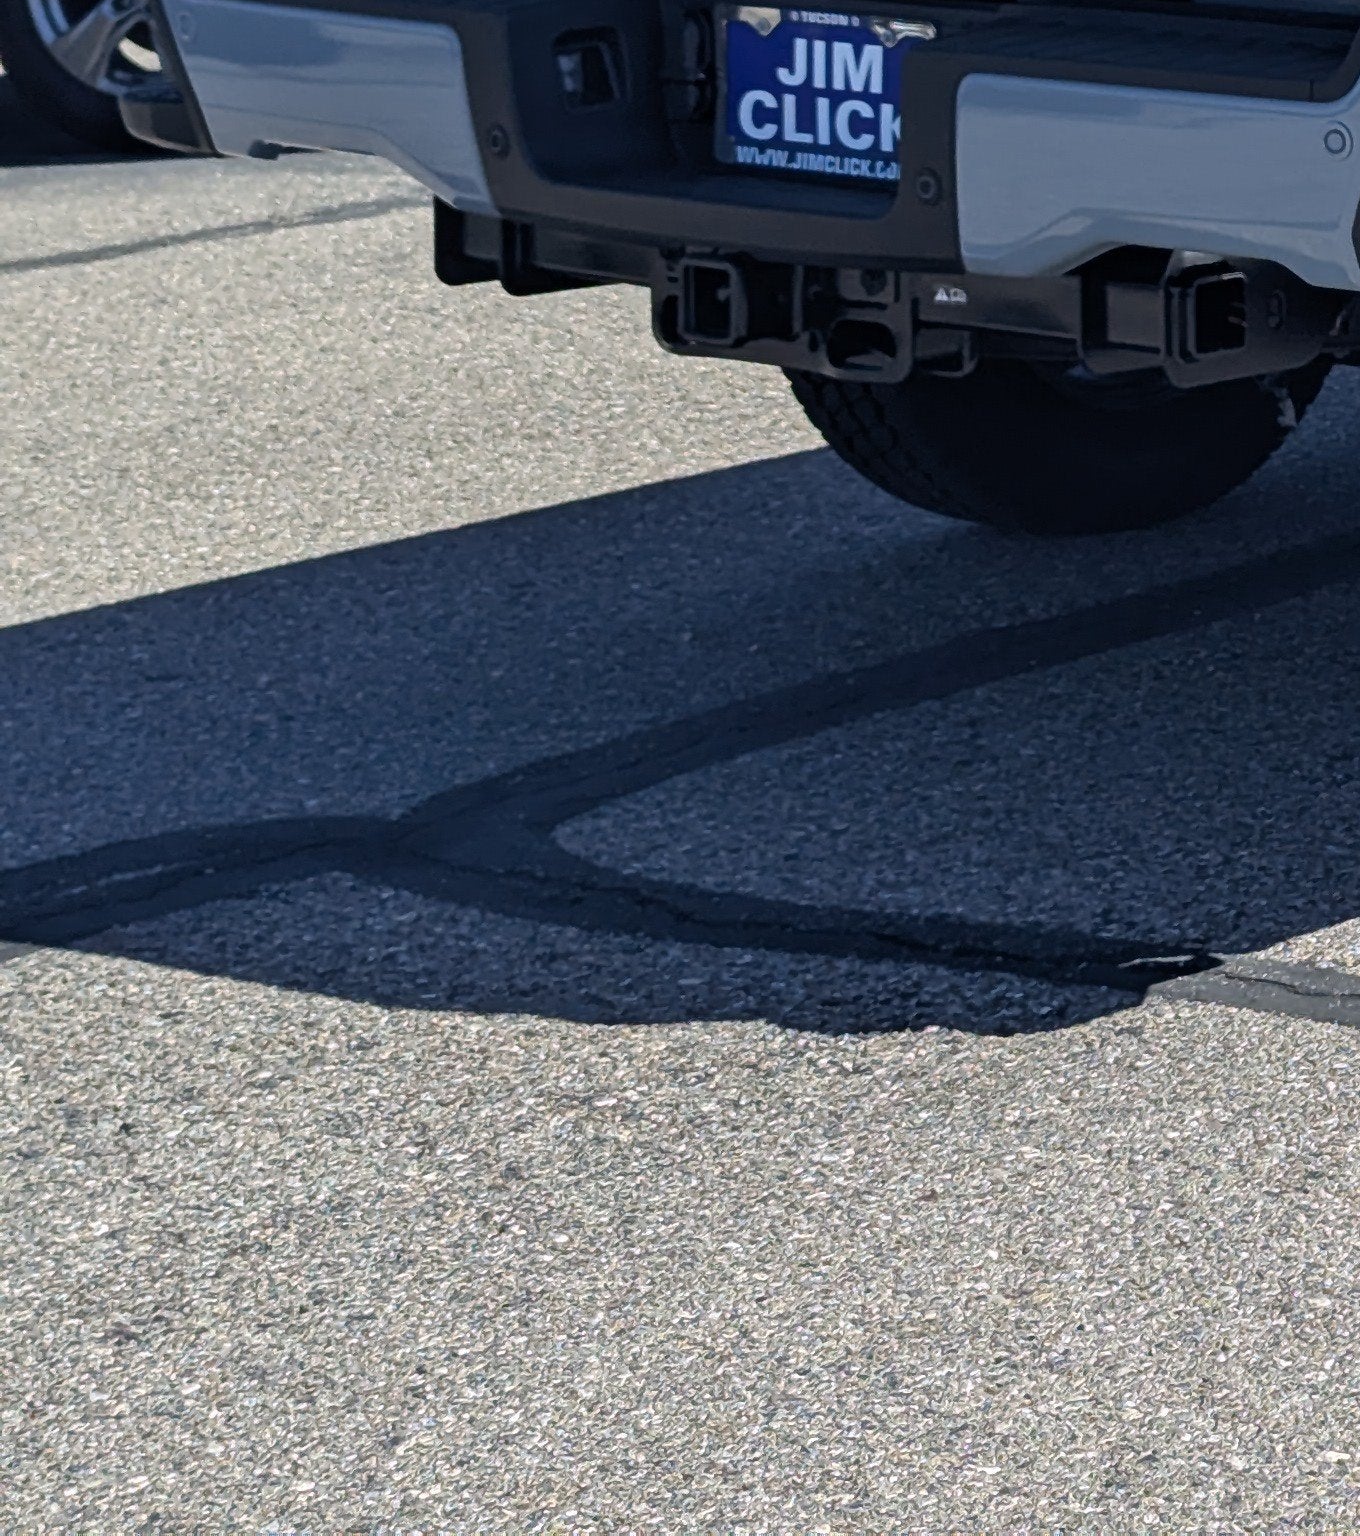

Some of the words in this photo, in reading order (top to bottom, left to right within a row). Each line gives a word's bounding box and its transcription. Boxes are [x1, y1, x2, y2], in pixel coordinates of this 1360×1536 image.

[801, 10, 849, 26] TUCSON
[776, 37, 884, 94] JIM
[736, 145, 900, 180] WWW.JIMCLICK.CO
